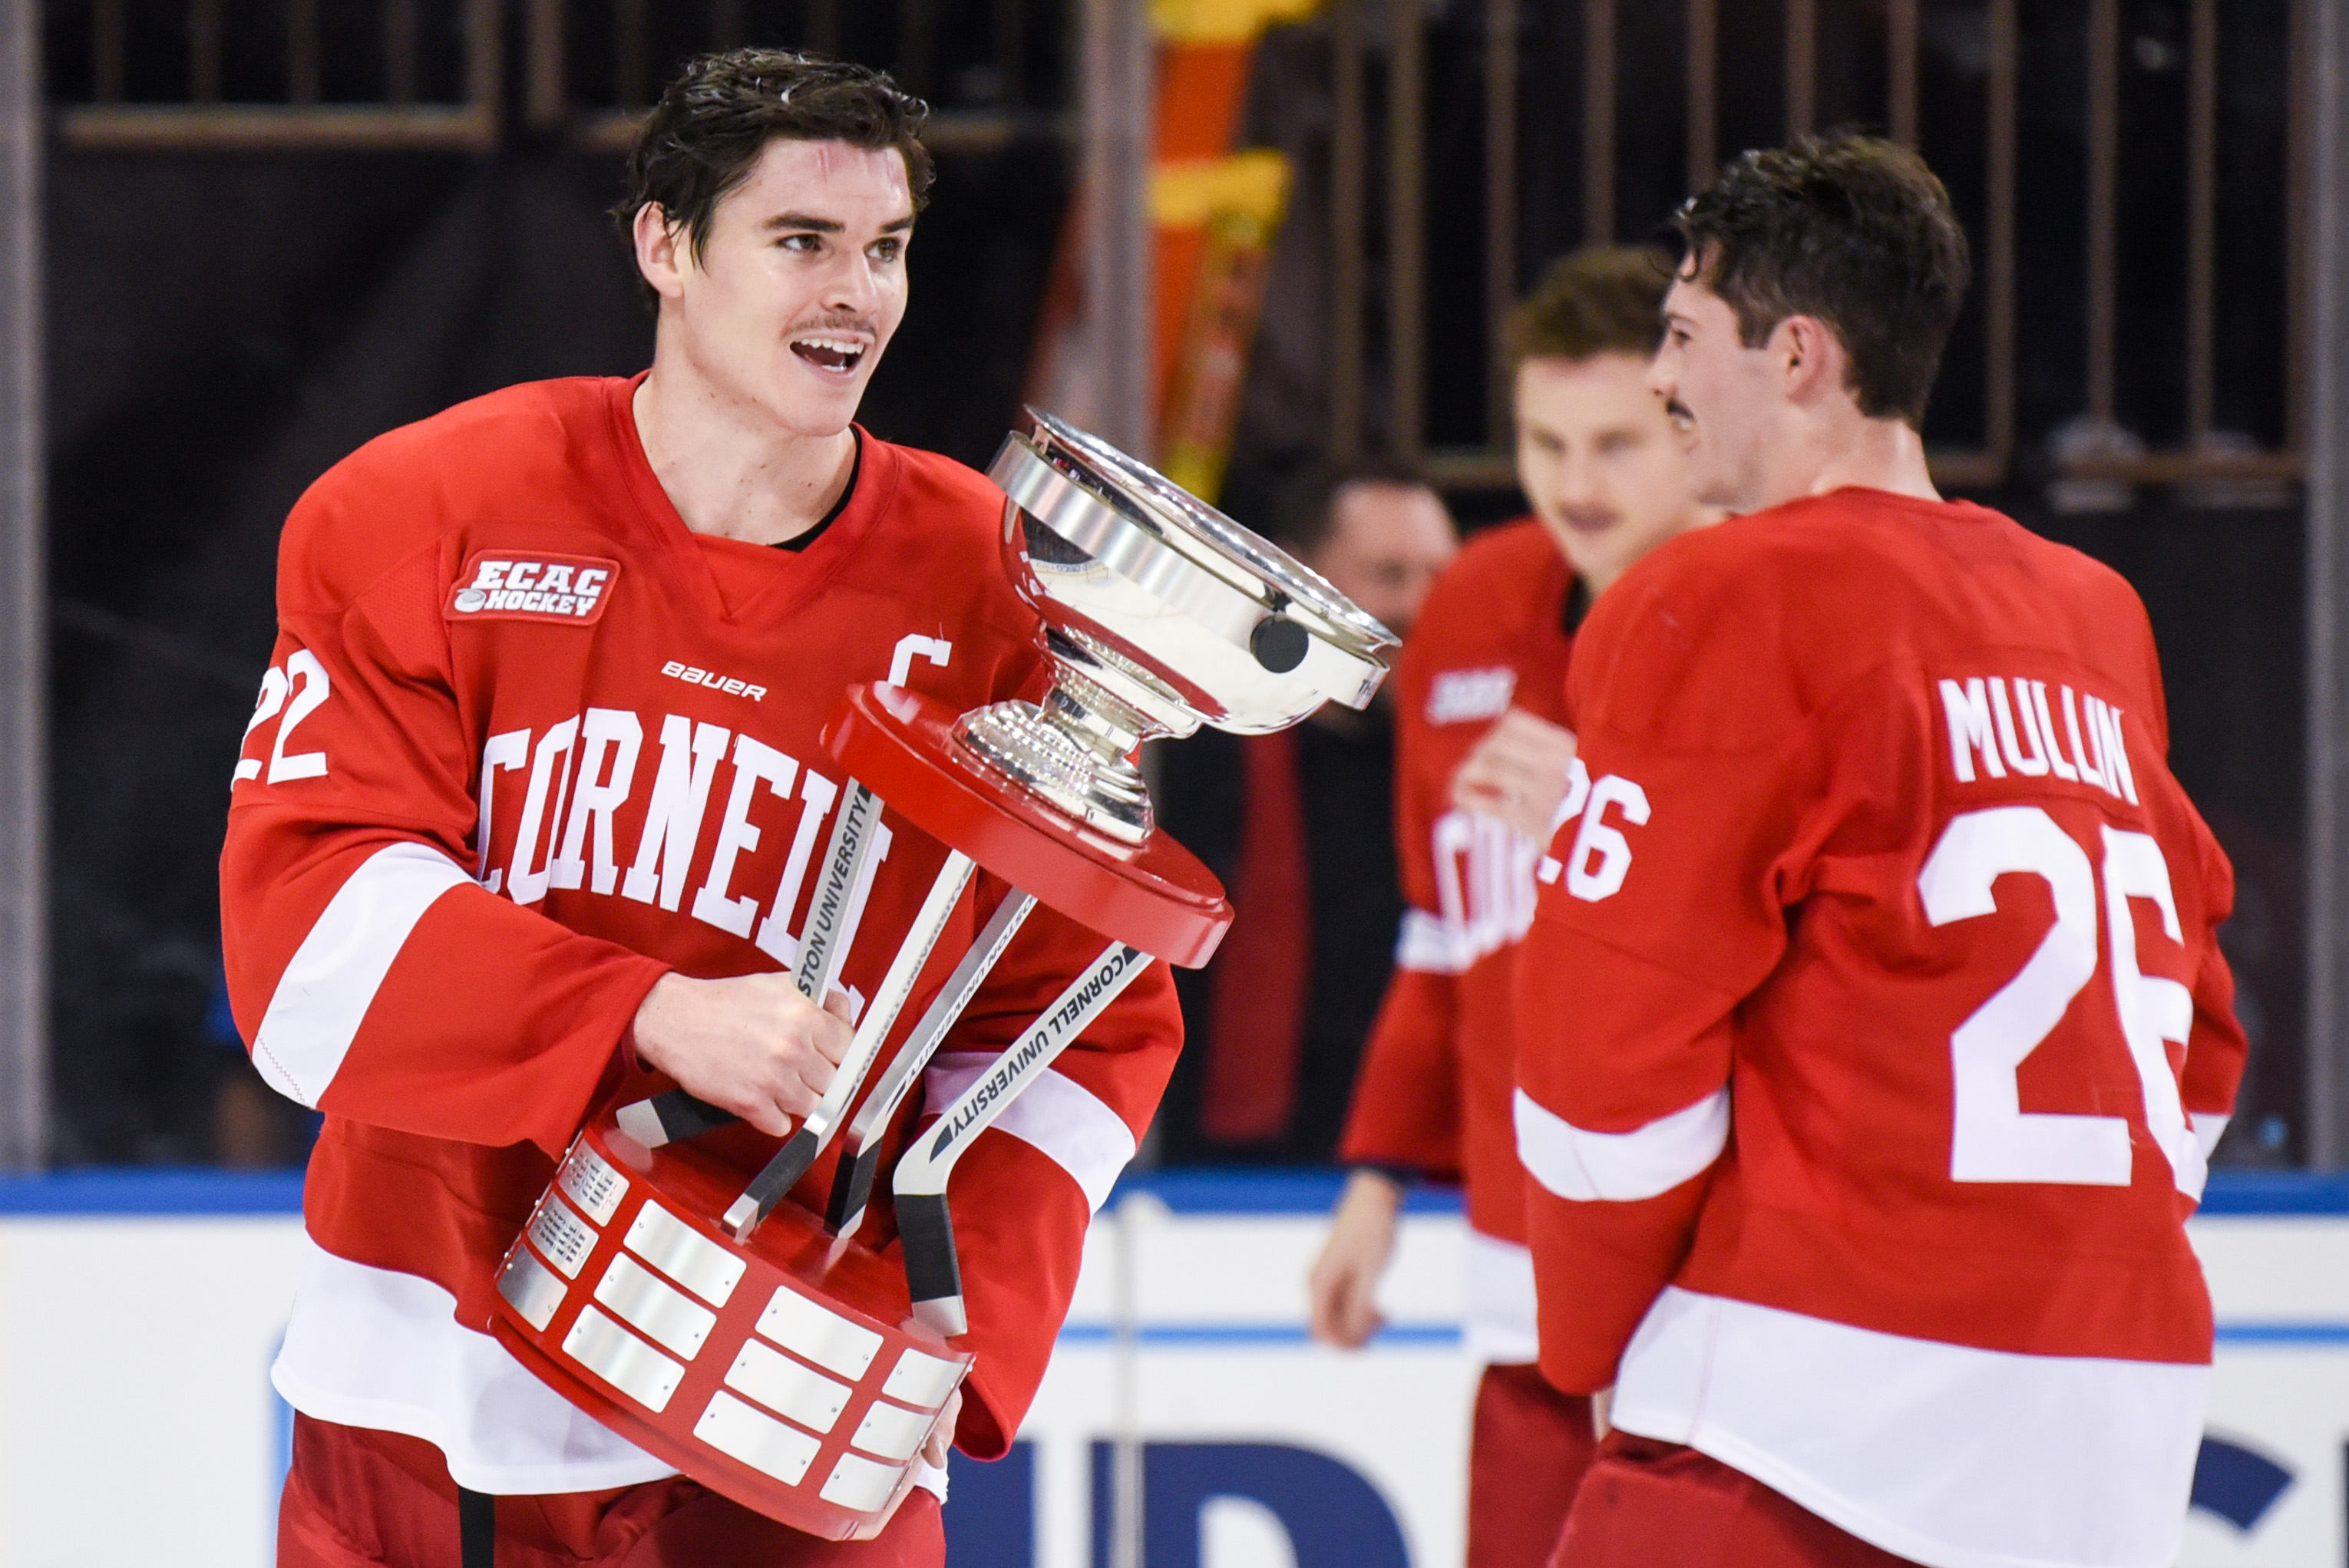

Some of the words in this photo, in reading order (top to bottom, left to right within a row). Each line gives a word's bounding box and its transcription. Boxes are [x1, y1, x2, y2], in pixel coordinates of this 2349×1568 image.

[471, 560, 609, 598] ECAC
[484, 589, 597, 617] HOCKEY
[230, 649, 330, 792] 22
[1938, 675, 2139, 806] MULLIN
[817, 797, 867, 933] UNIVERSITY
[987, 895, 1034, 966] OSTON
[1048, 955, 1125, 1035] CORNELL
[1917, 805, 2209, 1203] 26
[952, 1029, 1050, 1138] UNIVERSITY
